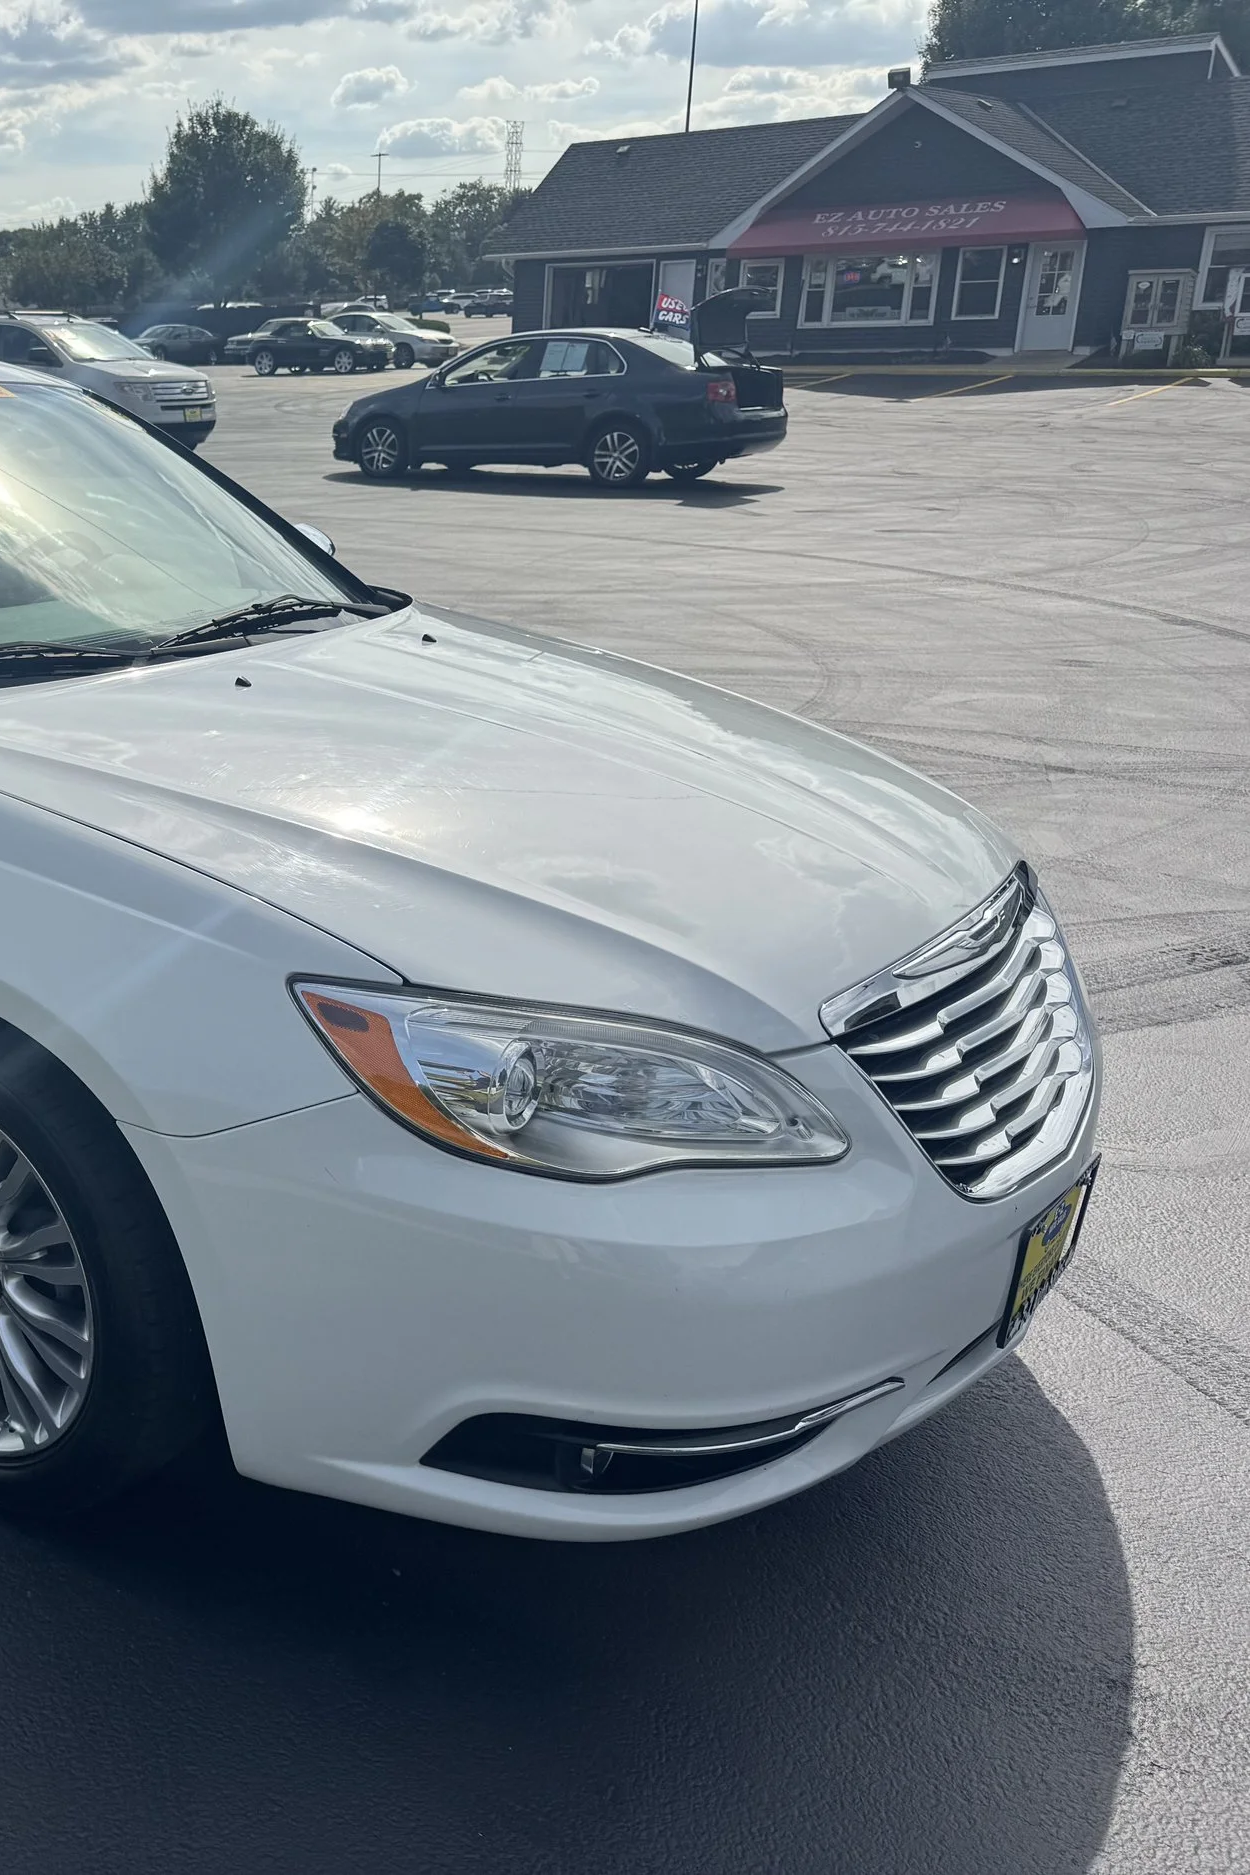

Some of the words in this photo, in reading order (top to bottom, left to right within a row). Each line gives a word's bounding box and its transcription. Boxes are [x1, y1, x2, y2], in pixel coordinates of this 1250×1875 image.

[812, 212, 841, 225] EZ
[844, 207, 919, 223] AUTO
[924, 200, 1006, 216] SALES
[822, 216, 980, 238] 815-744-1821
[658, 310, 690, 325] CARS
